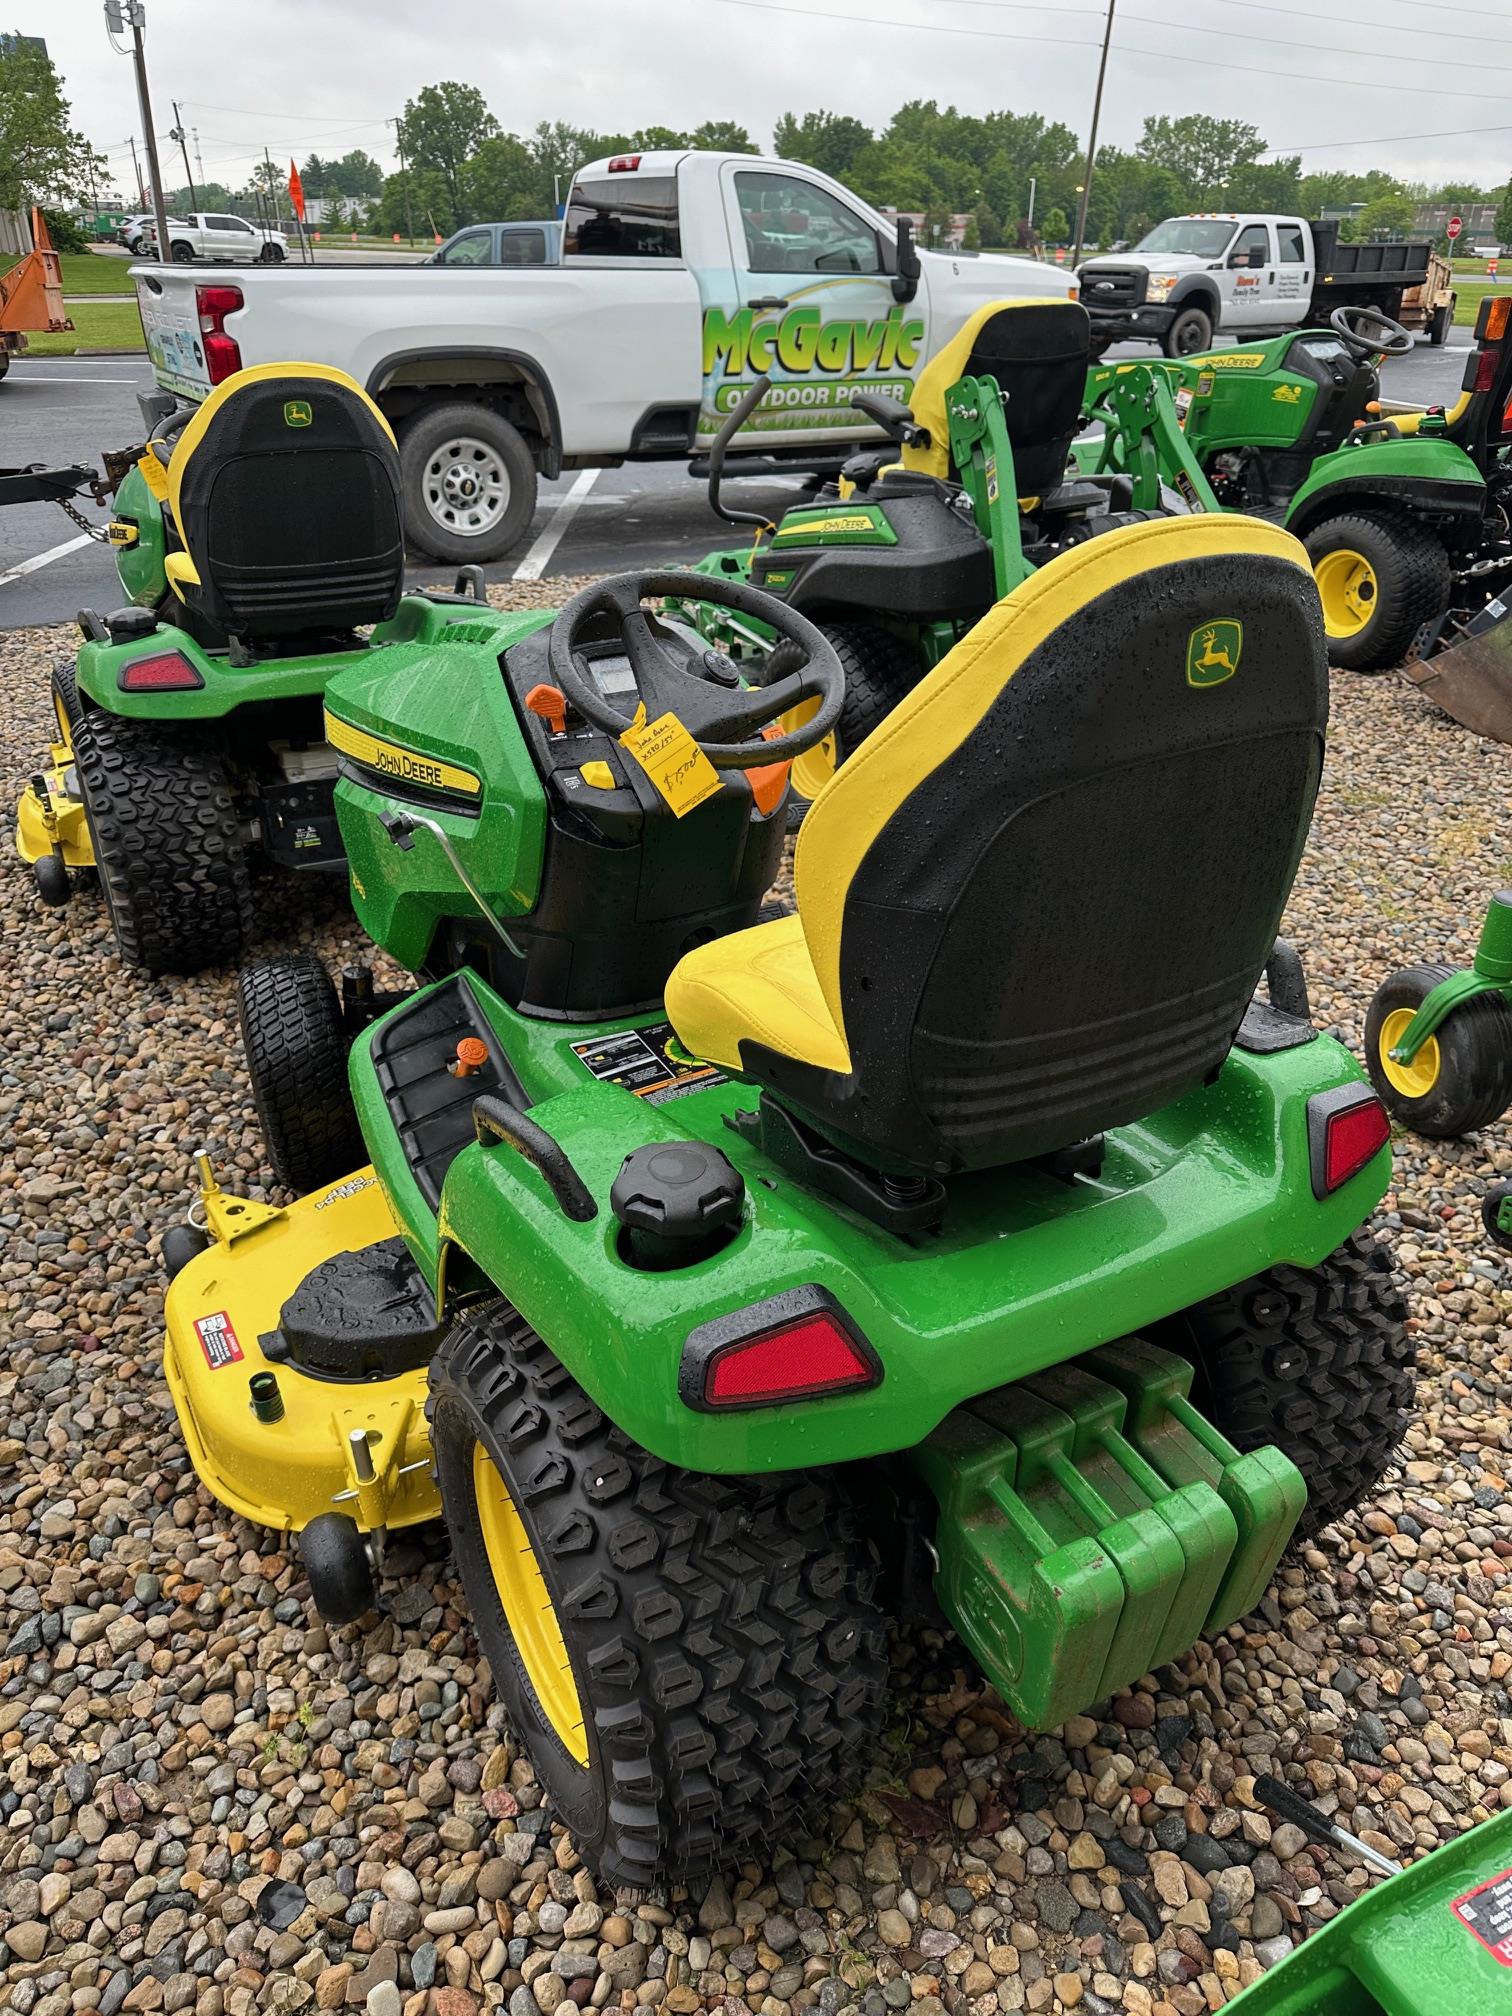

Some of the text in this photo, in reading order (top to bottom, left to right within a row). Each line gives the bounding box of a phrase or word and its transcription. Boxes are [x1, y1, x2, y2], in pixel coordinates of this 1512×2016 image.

[702, 306, 925, 376] McGavic
[1227, 357, 1258, 367] DEERE
[726, 386, 829, 409] OTDOOR
[821, 519, 867, 531] JOHN DEERE
[375, 748, 442, 785] JOHN DEERE
